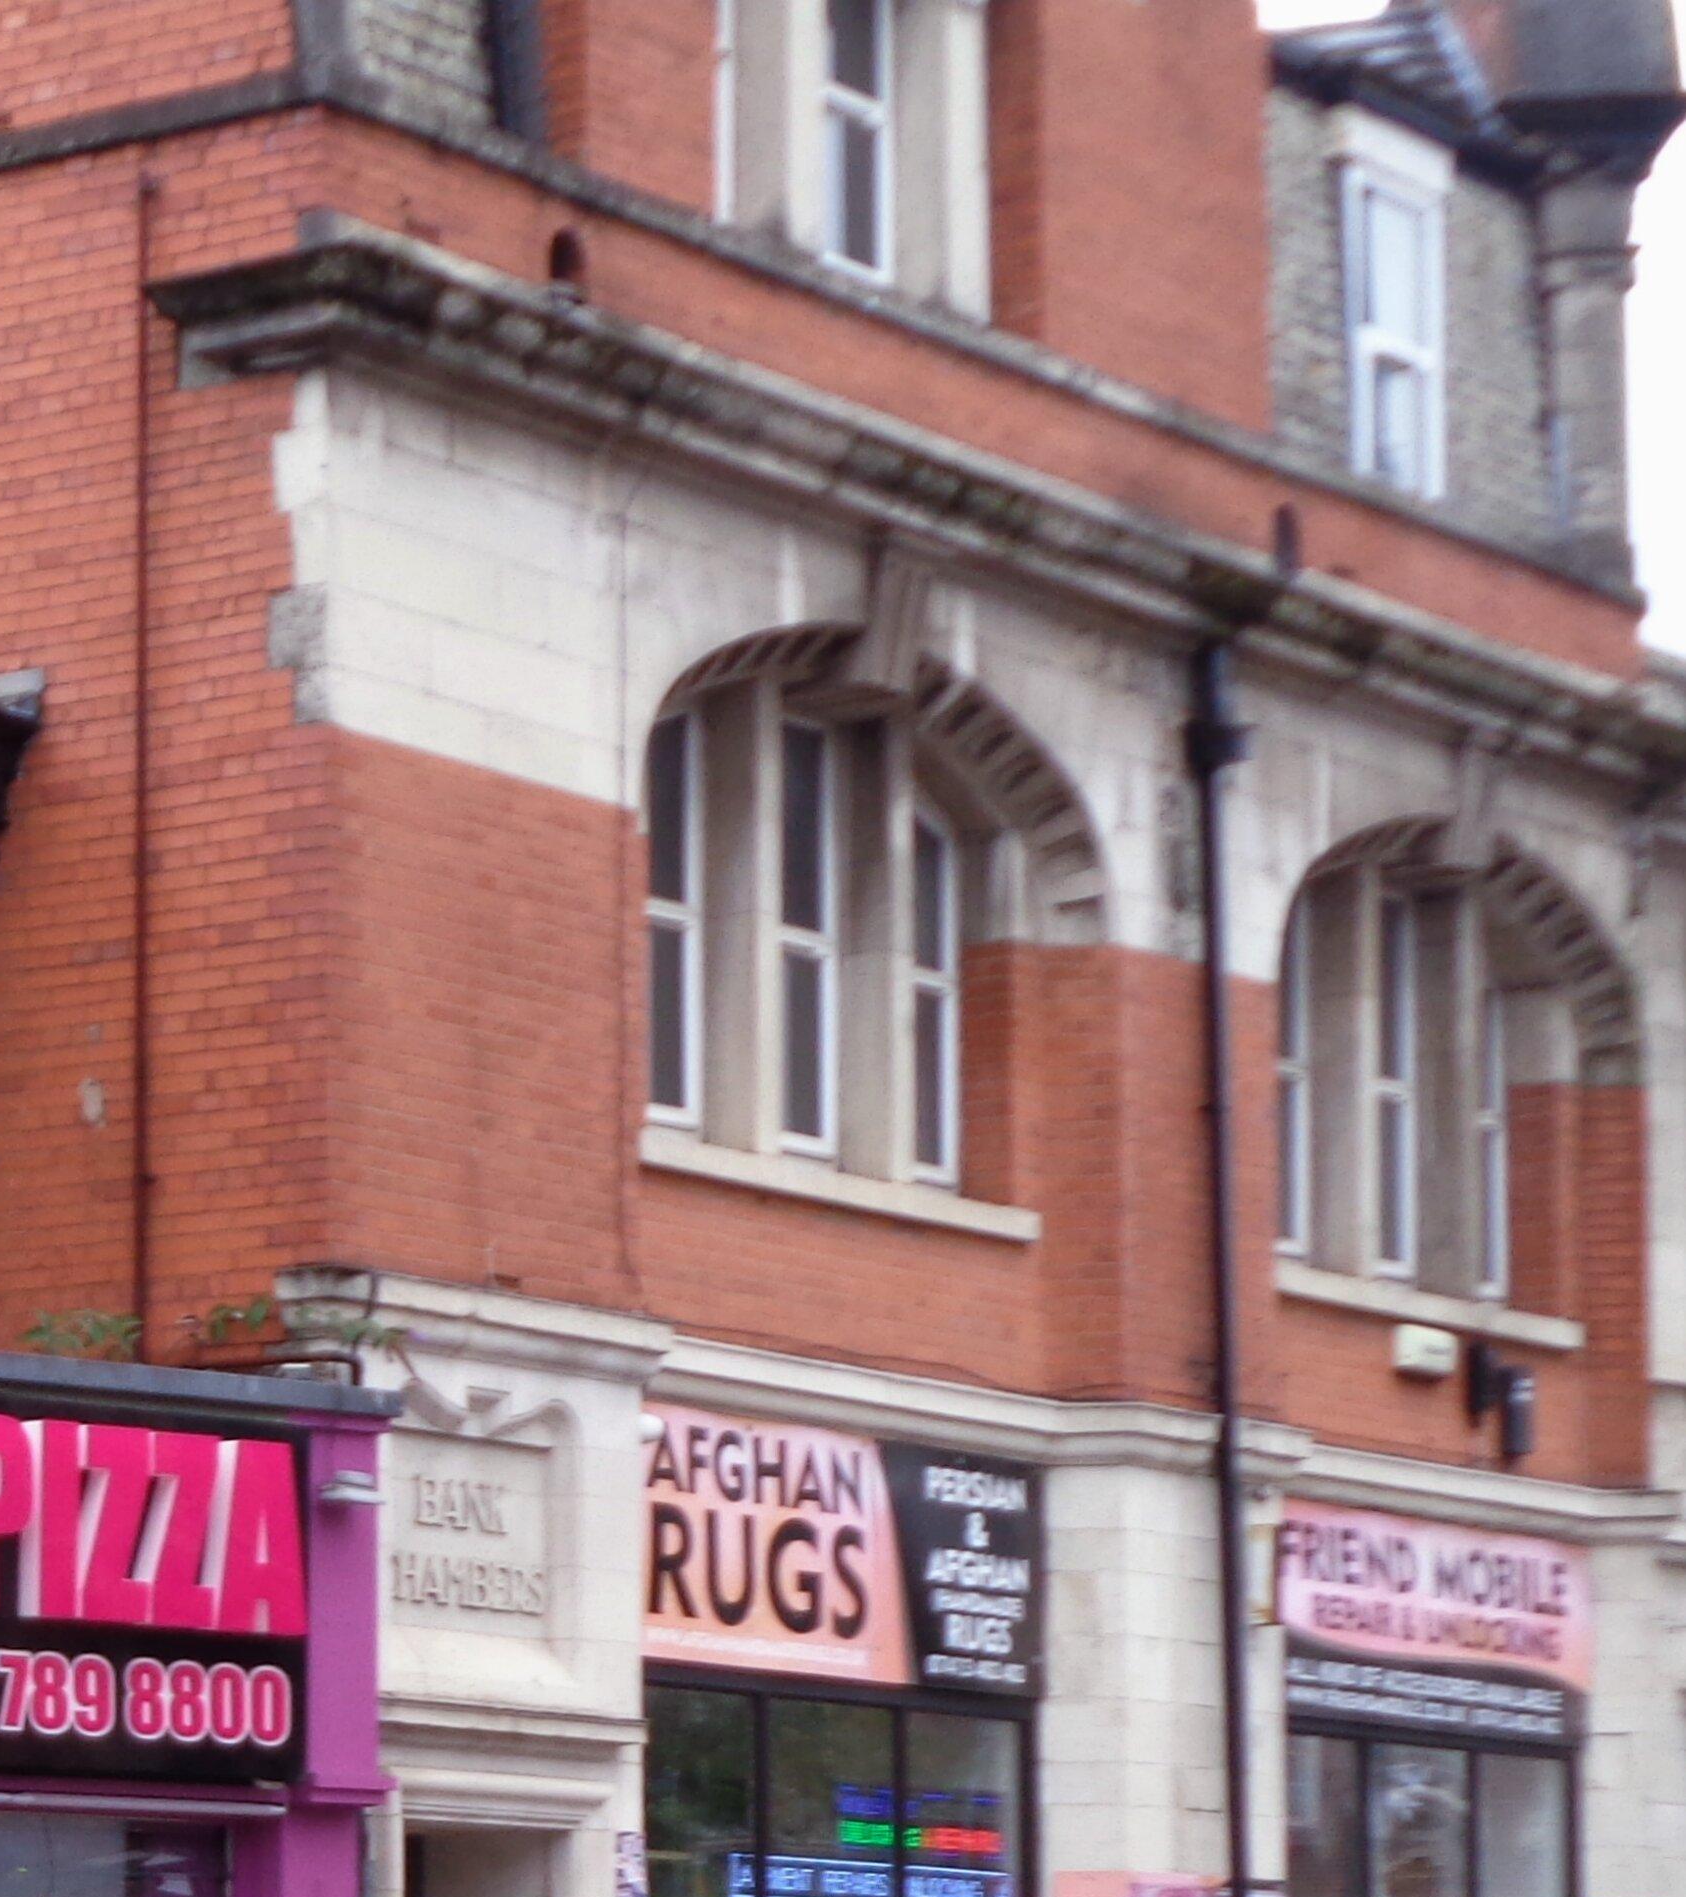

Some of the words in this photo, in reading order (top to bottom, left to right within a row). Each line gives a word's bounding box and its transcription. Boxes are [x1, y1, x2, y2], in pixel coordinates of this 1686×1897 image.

[411, 1474, 509, 1536] BANK
[645, 1422, 864, 1515] AFGHAN
[390, 1554, 543, 1618] HAMBERS
[646, 1501, 868, 1640] RUGS
[123, 1657, 293, 1748] 8800
